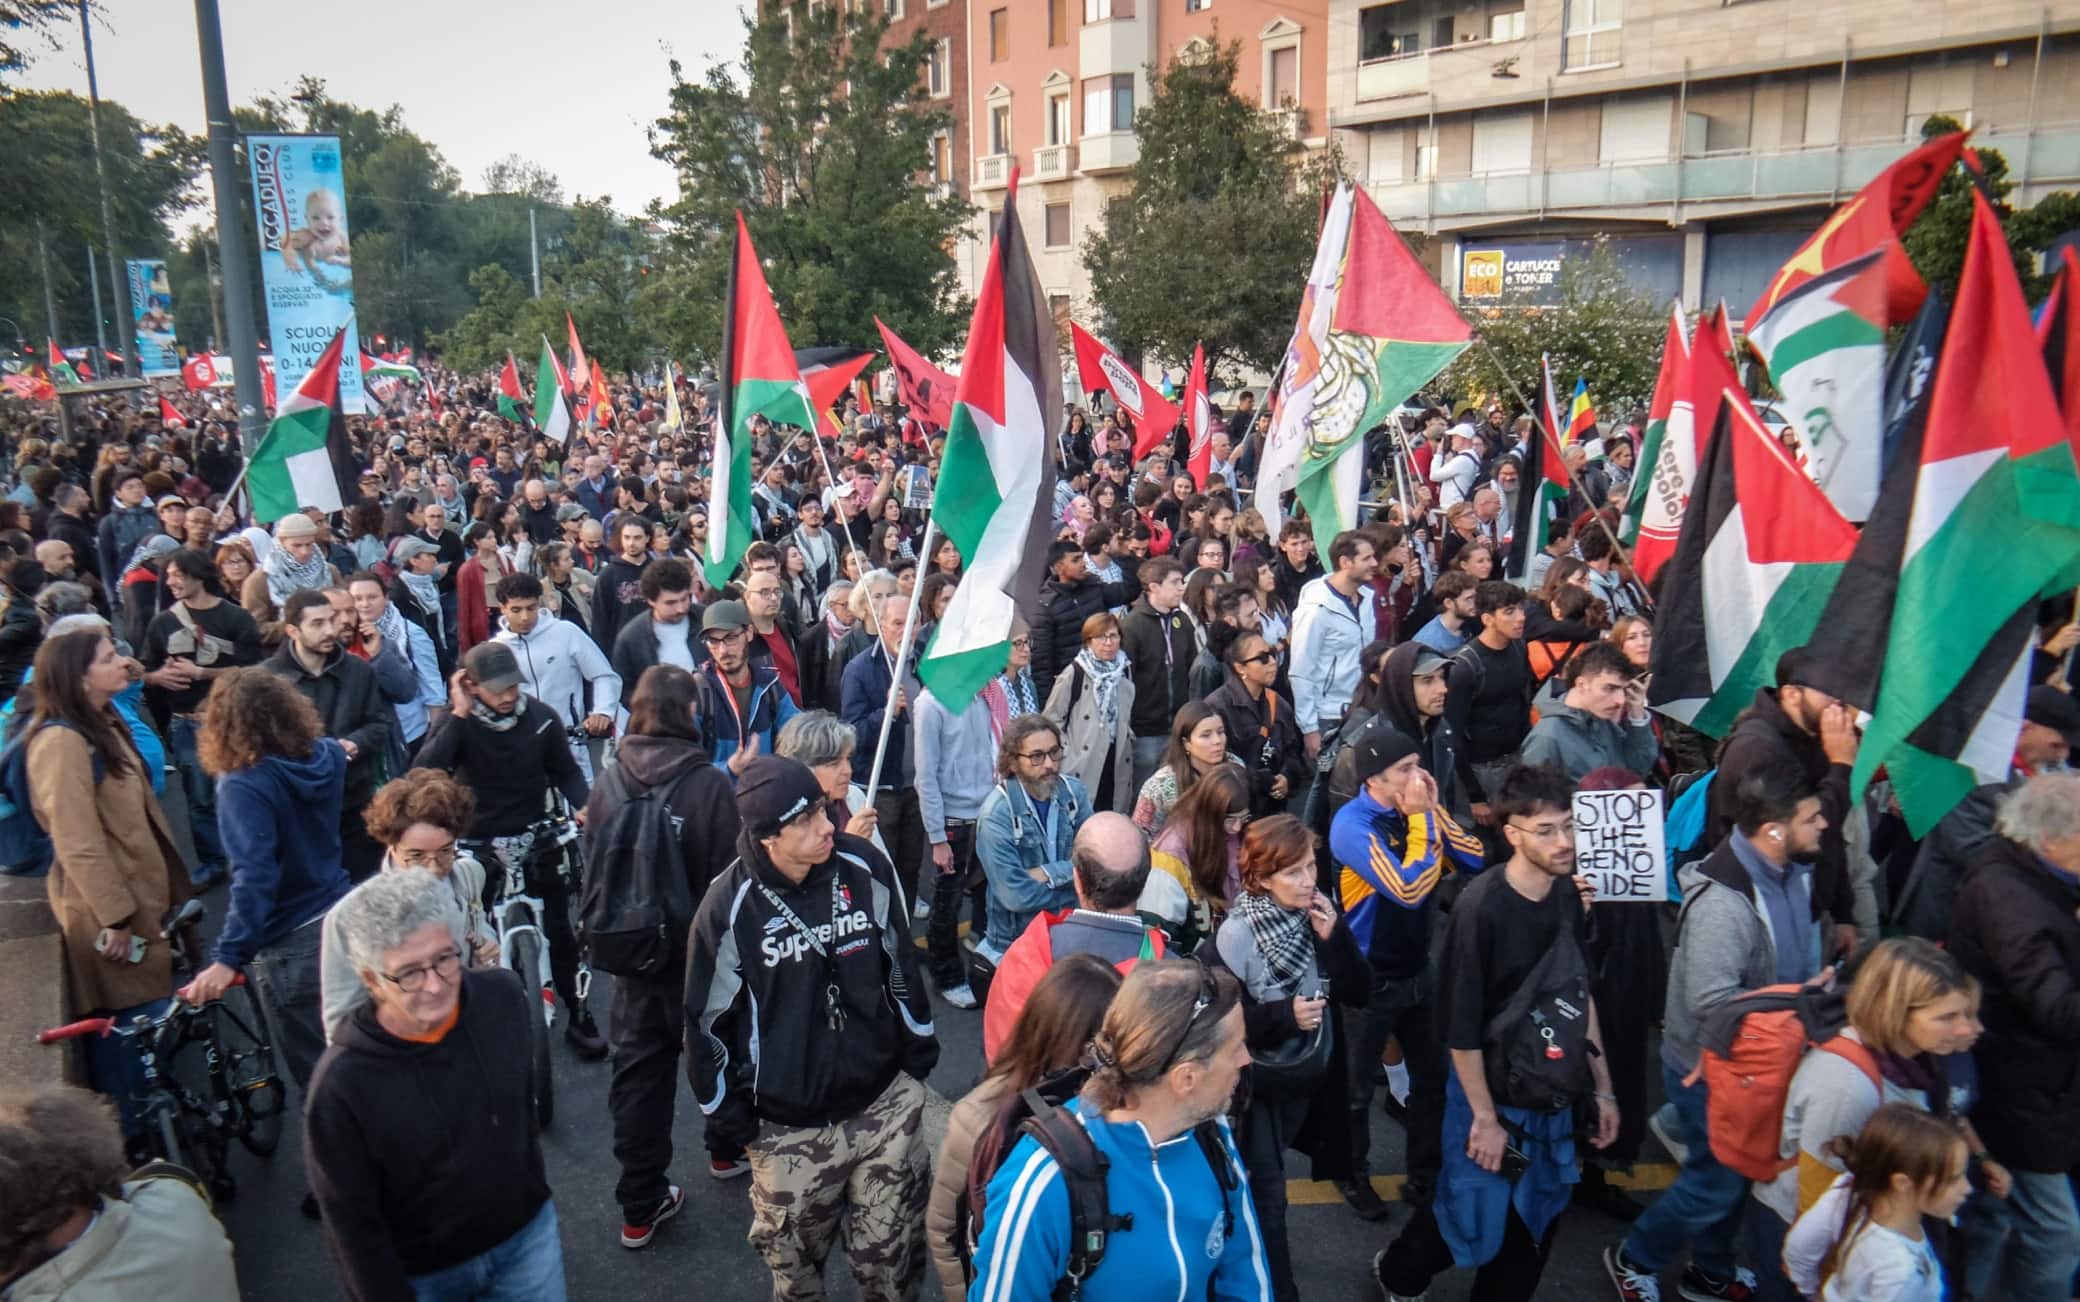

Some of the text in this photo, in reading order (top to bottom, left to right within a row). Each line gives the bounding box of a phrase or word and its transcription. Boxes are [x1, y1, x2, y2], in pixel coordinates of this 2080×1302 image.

[1469, 263, 1498, 278] ECO
[1505, 259, 1561, 272] CARTUCCE
[1514, 272, 1554, 284] TONER
[1661, 438, 1685, 489] tere
[1577, 790, 1656, 827] STOP
[1578, 823, 1648, 850] THE
[1578, 848, 1654, 874] GENO
